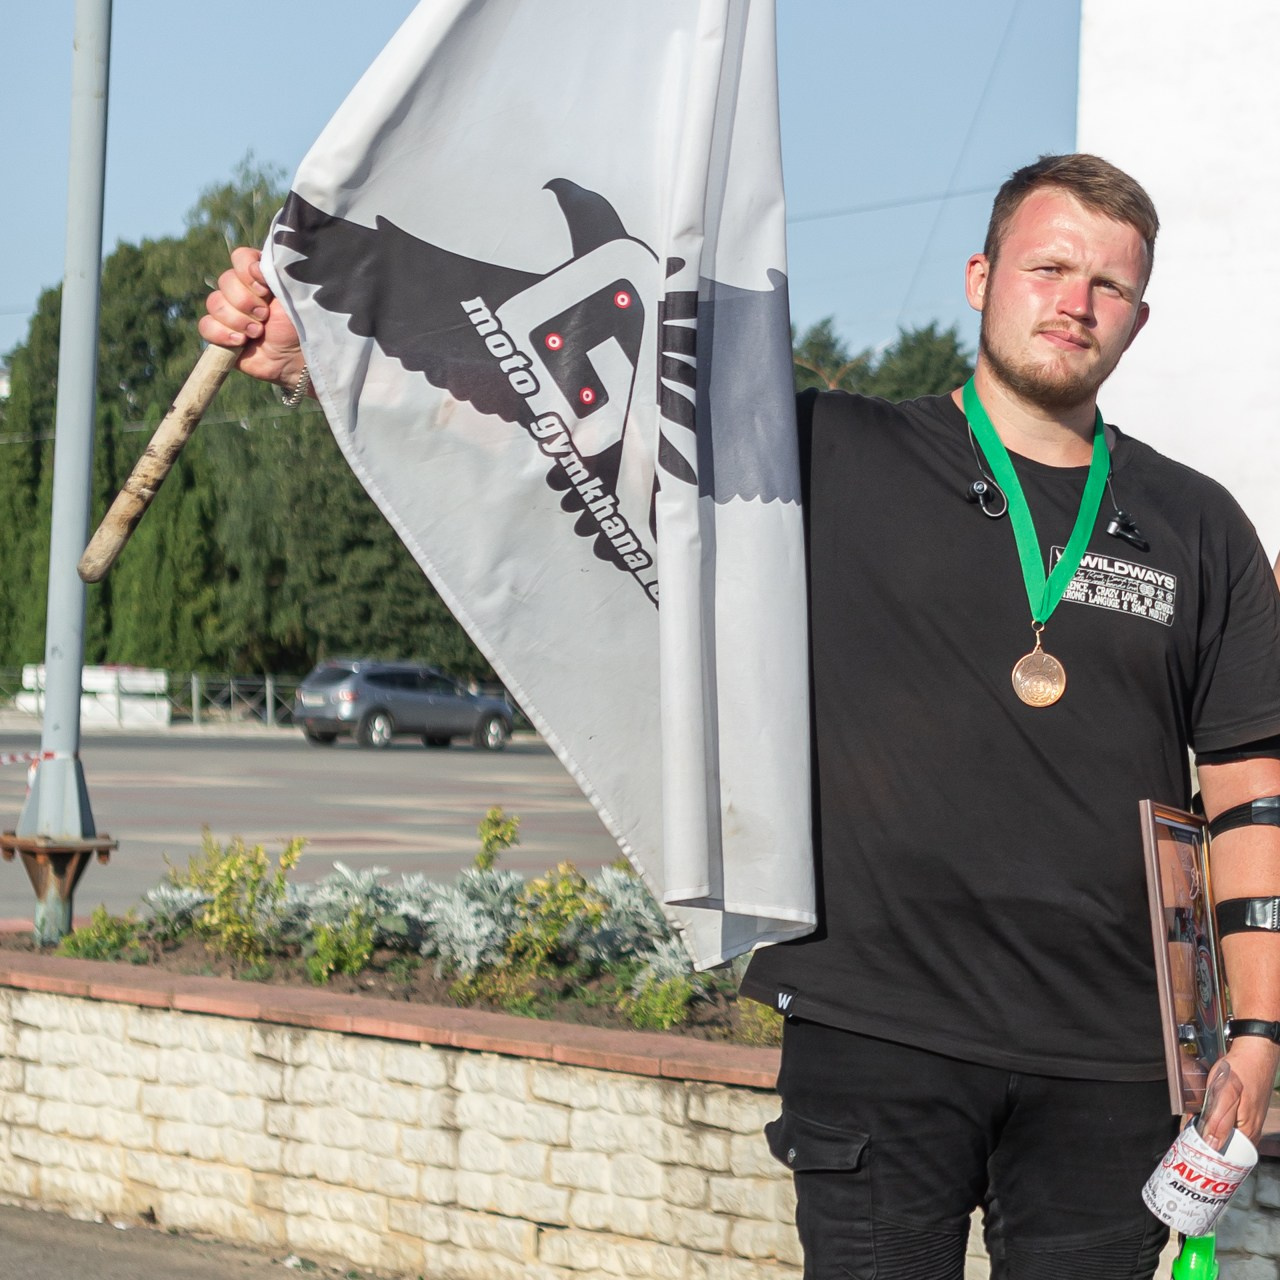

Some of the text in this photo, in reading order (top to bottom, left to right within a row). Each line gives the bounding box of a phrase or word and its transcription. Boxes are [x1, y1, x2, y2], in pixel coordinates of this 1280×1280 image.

[460, 296, 649, 569] moto gymkhana
[1080, 556, 1174, 590] WILDWAYS
[778, 992, 793, 1010] W
